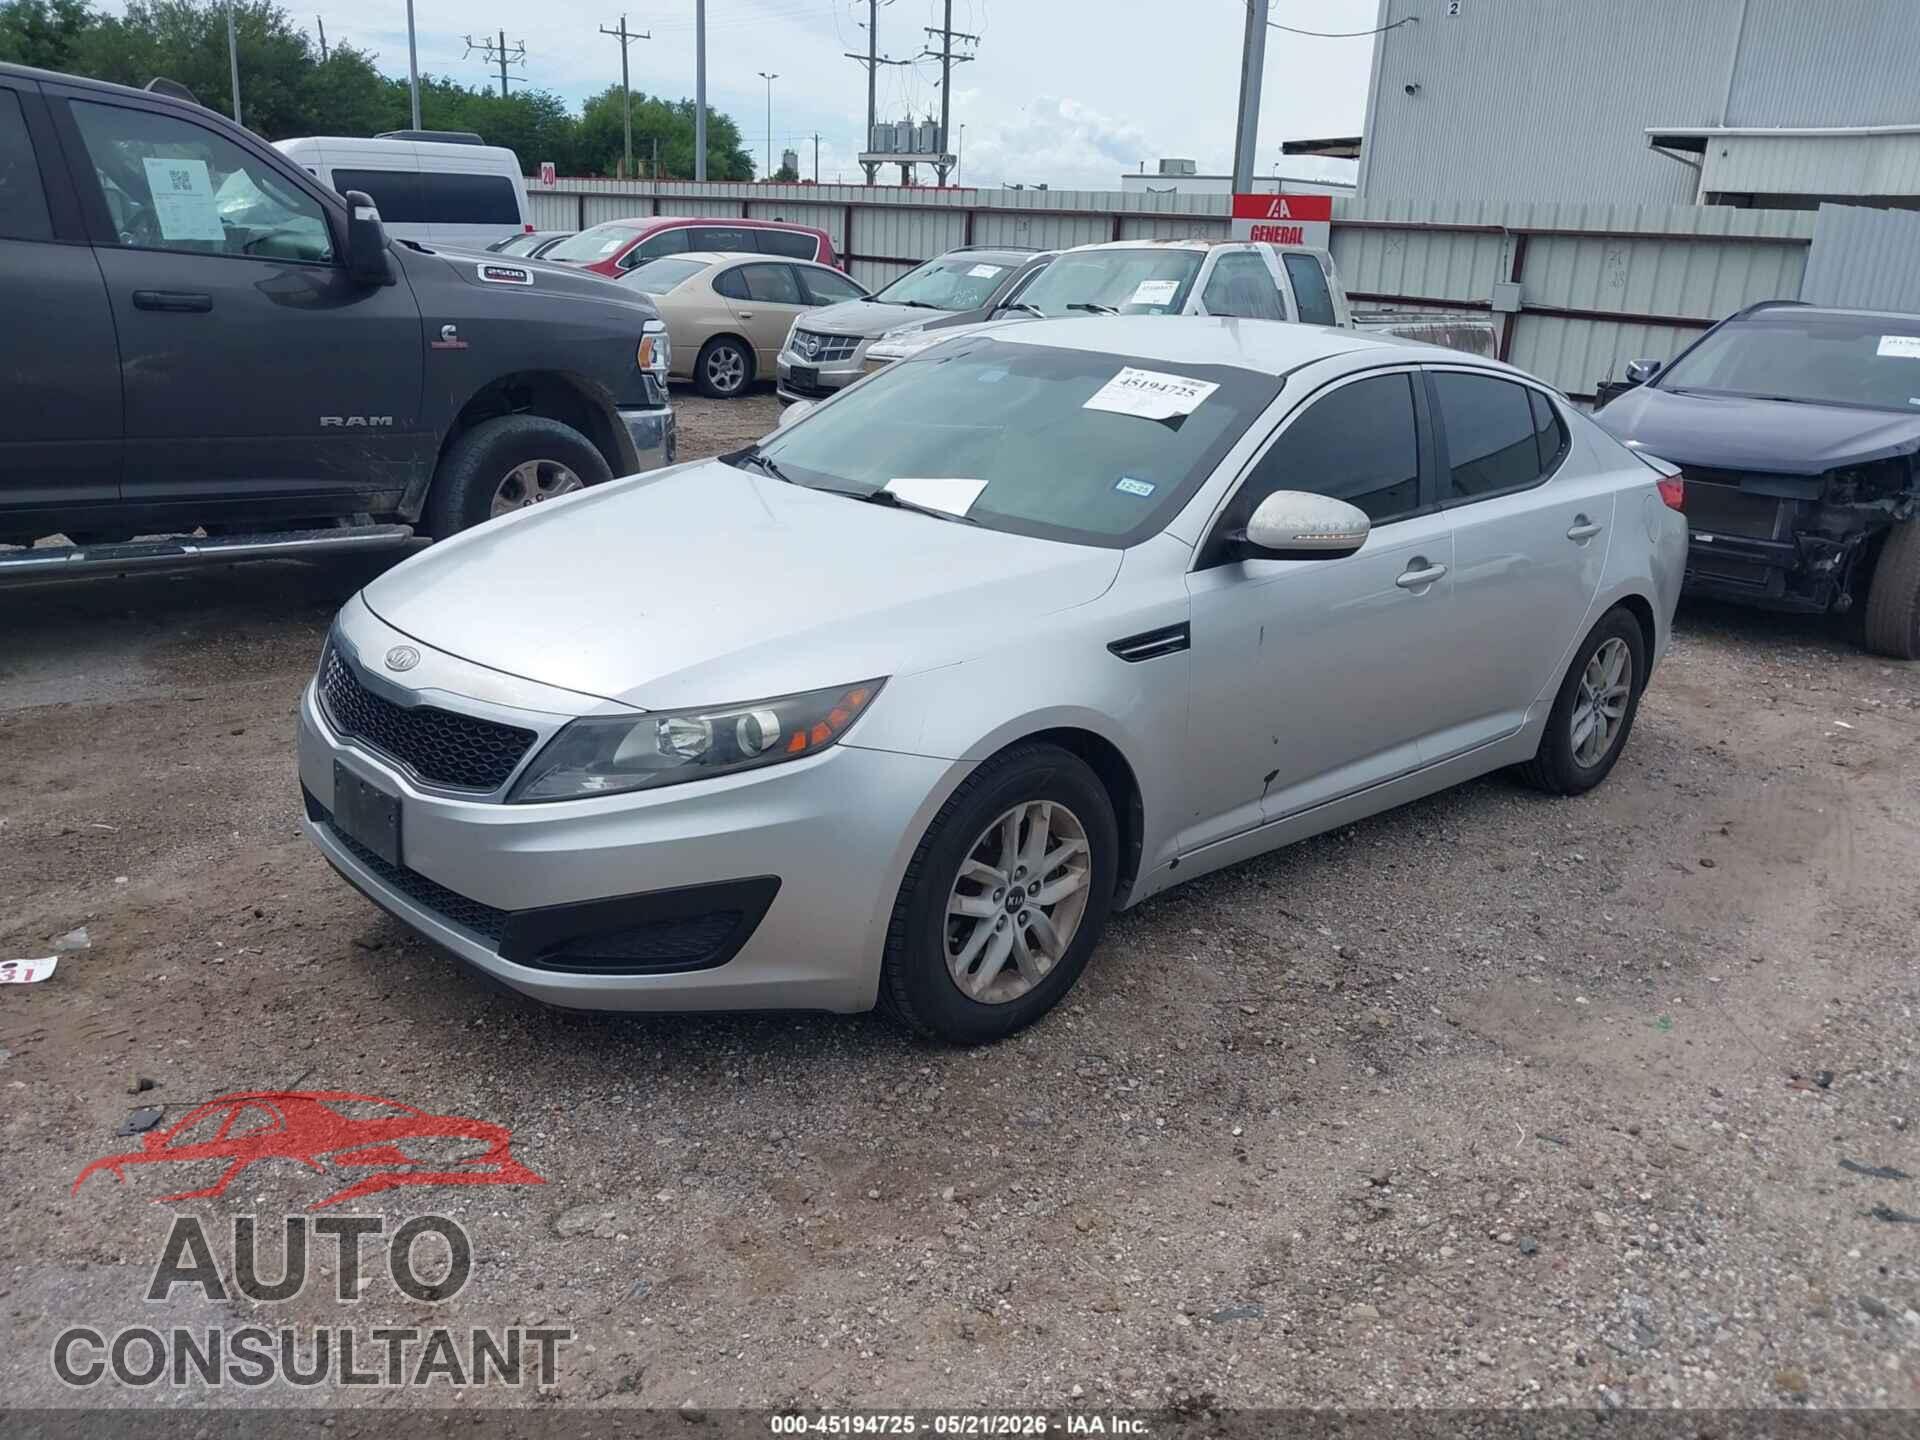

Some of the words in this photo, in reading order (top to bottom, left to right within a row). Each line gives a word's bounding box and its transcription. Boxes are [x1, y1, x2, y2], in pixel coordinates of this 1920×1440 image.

[1450, 3, 1459, 14] 2
[543, 166, 554, 185] 20
[1250, 224, 1305, 246] GENERAL
[1120, 378, 1198, 397] 45194725
[319, 415, 393, 427] RAM
[1007, 895, 1025, 906] KIA
